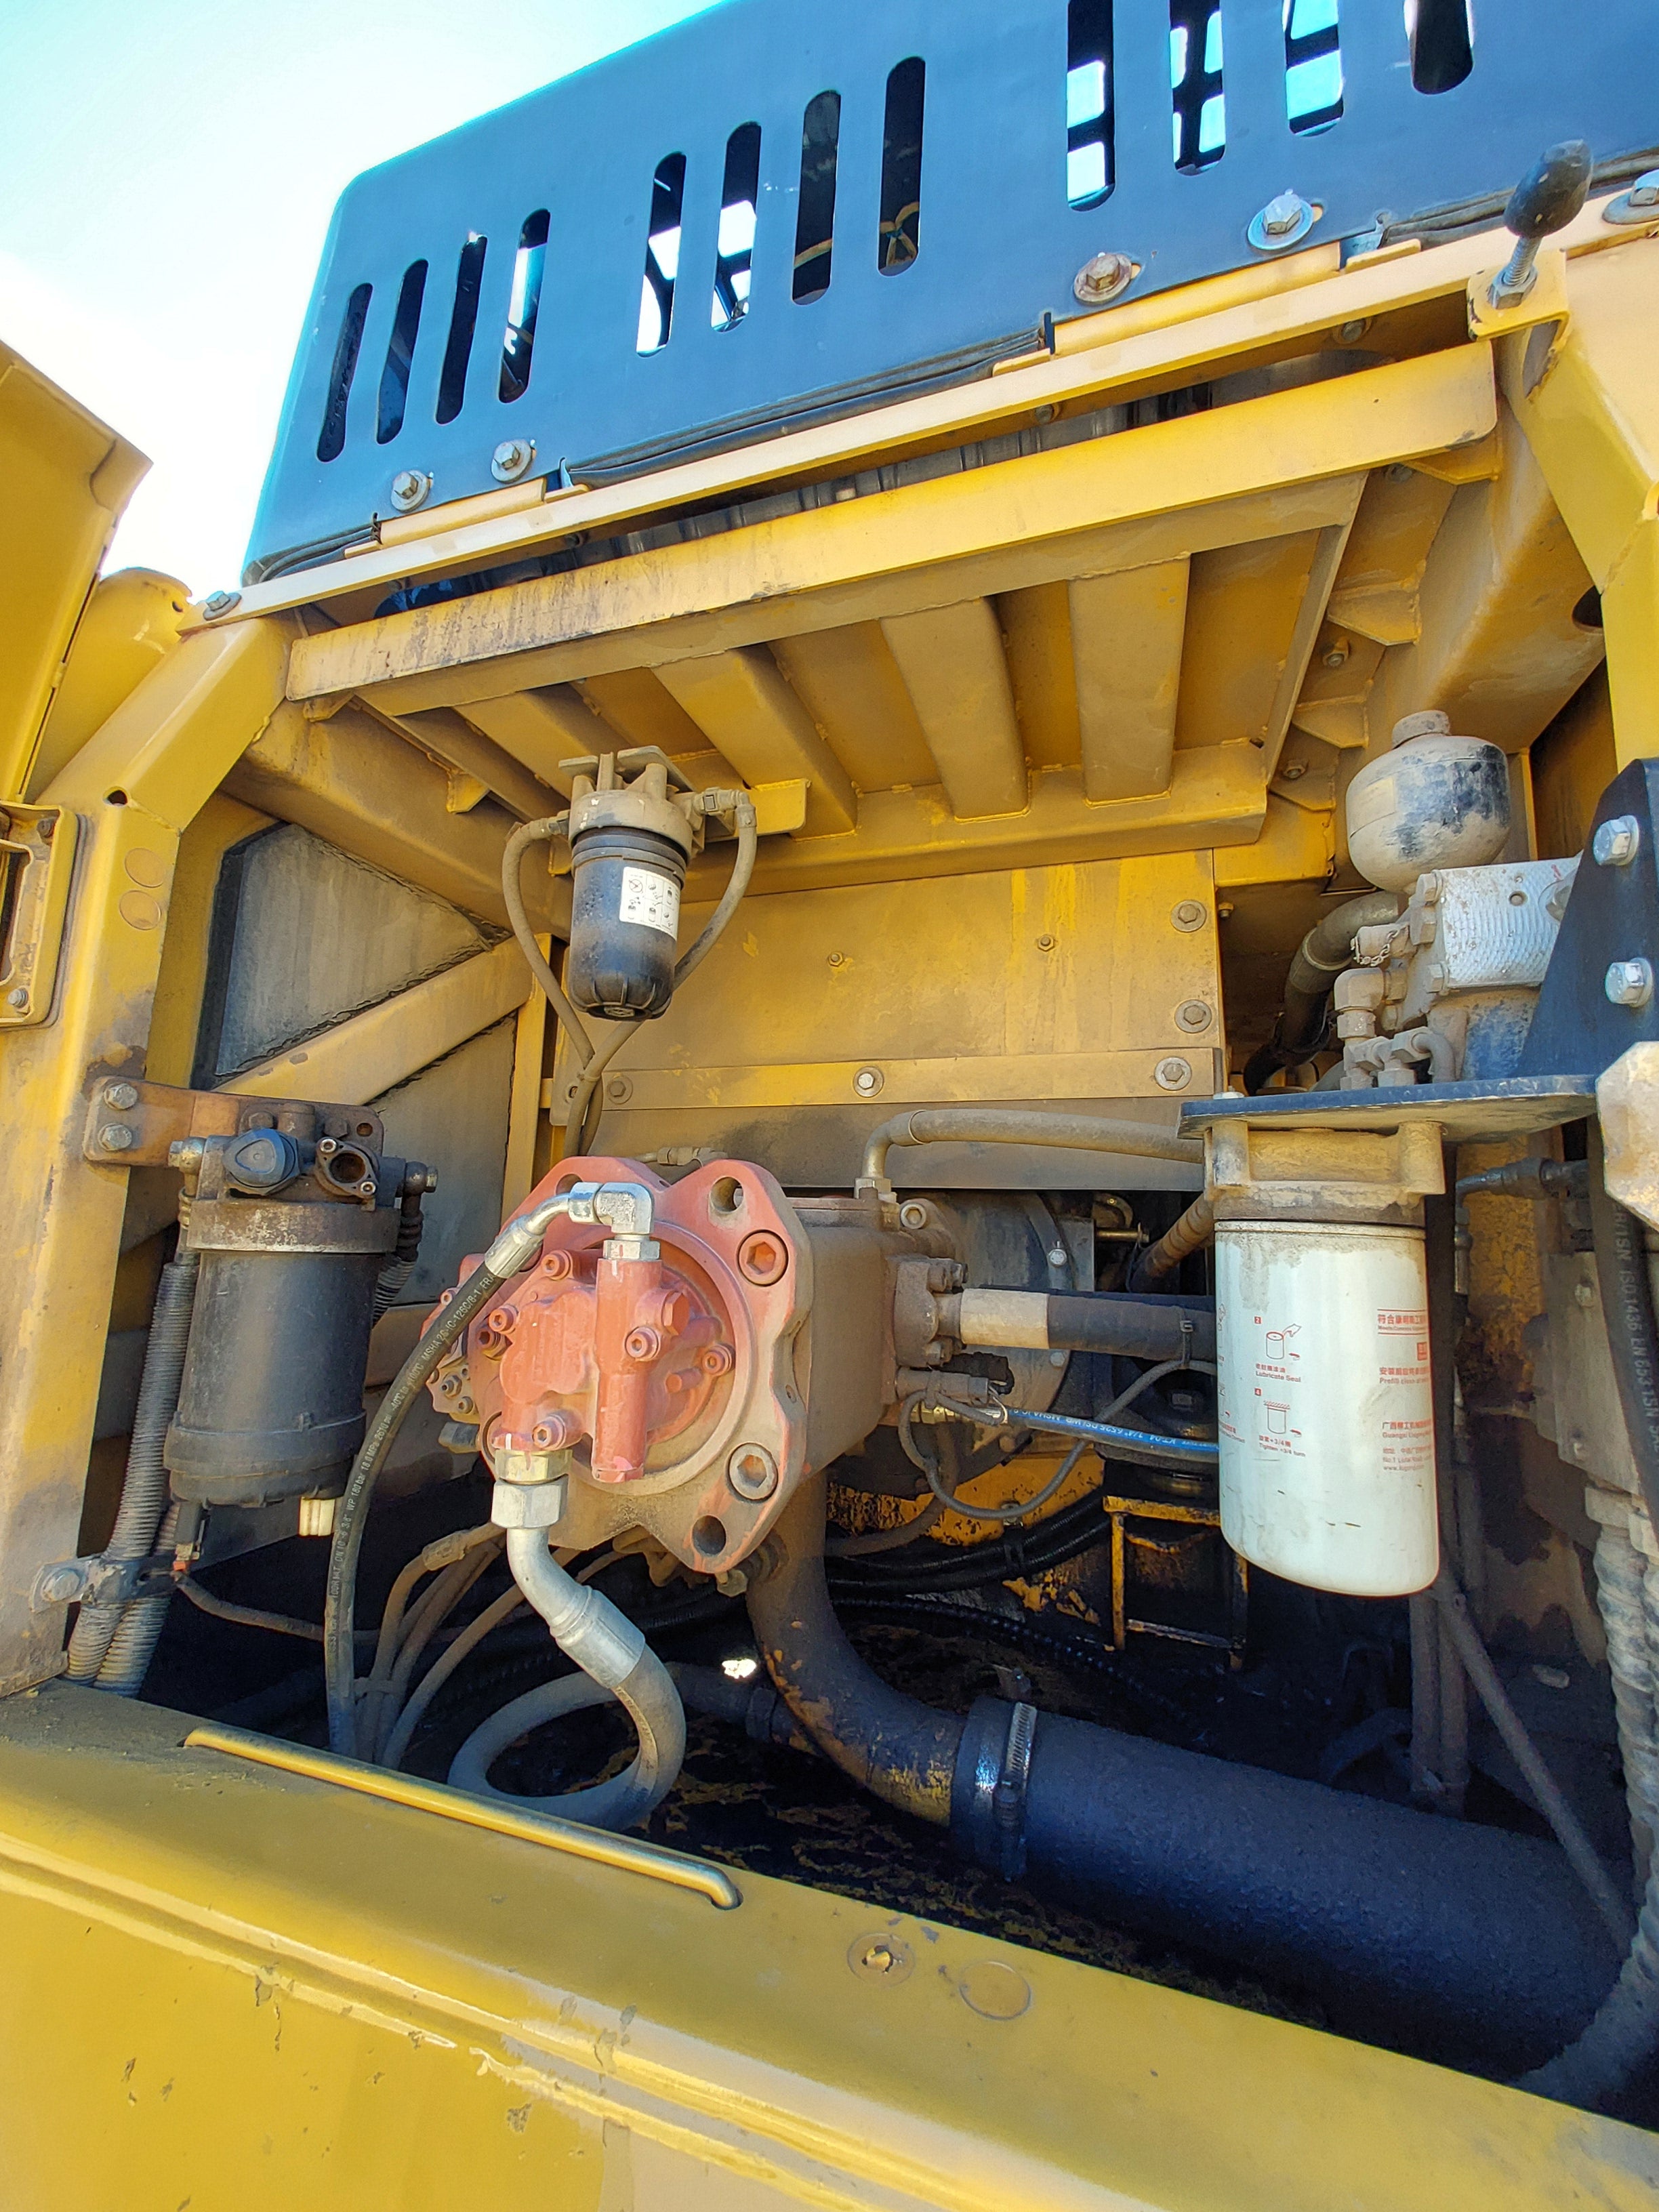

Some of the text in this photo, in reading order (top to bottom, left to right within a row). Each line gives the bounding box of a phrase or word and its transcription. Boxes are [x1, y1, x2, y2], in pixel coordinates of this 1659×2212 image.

[1256, 1370, 1301, 1382] Lubricate Seal
[346, 1498, 356, 1511] WP
[421, 1340, 442, 1361] MSHA
